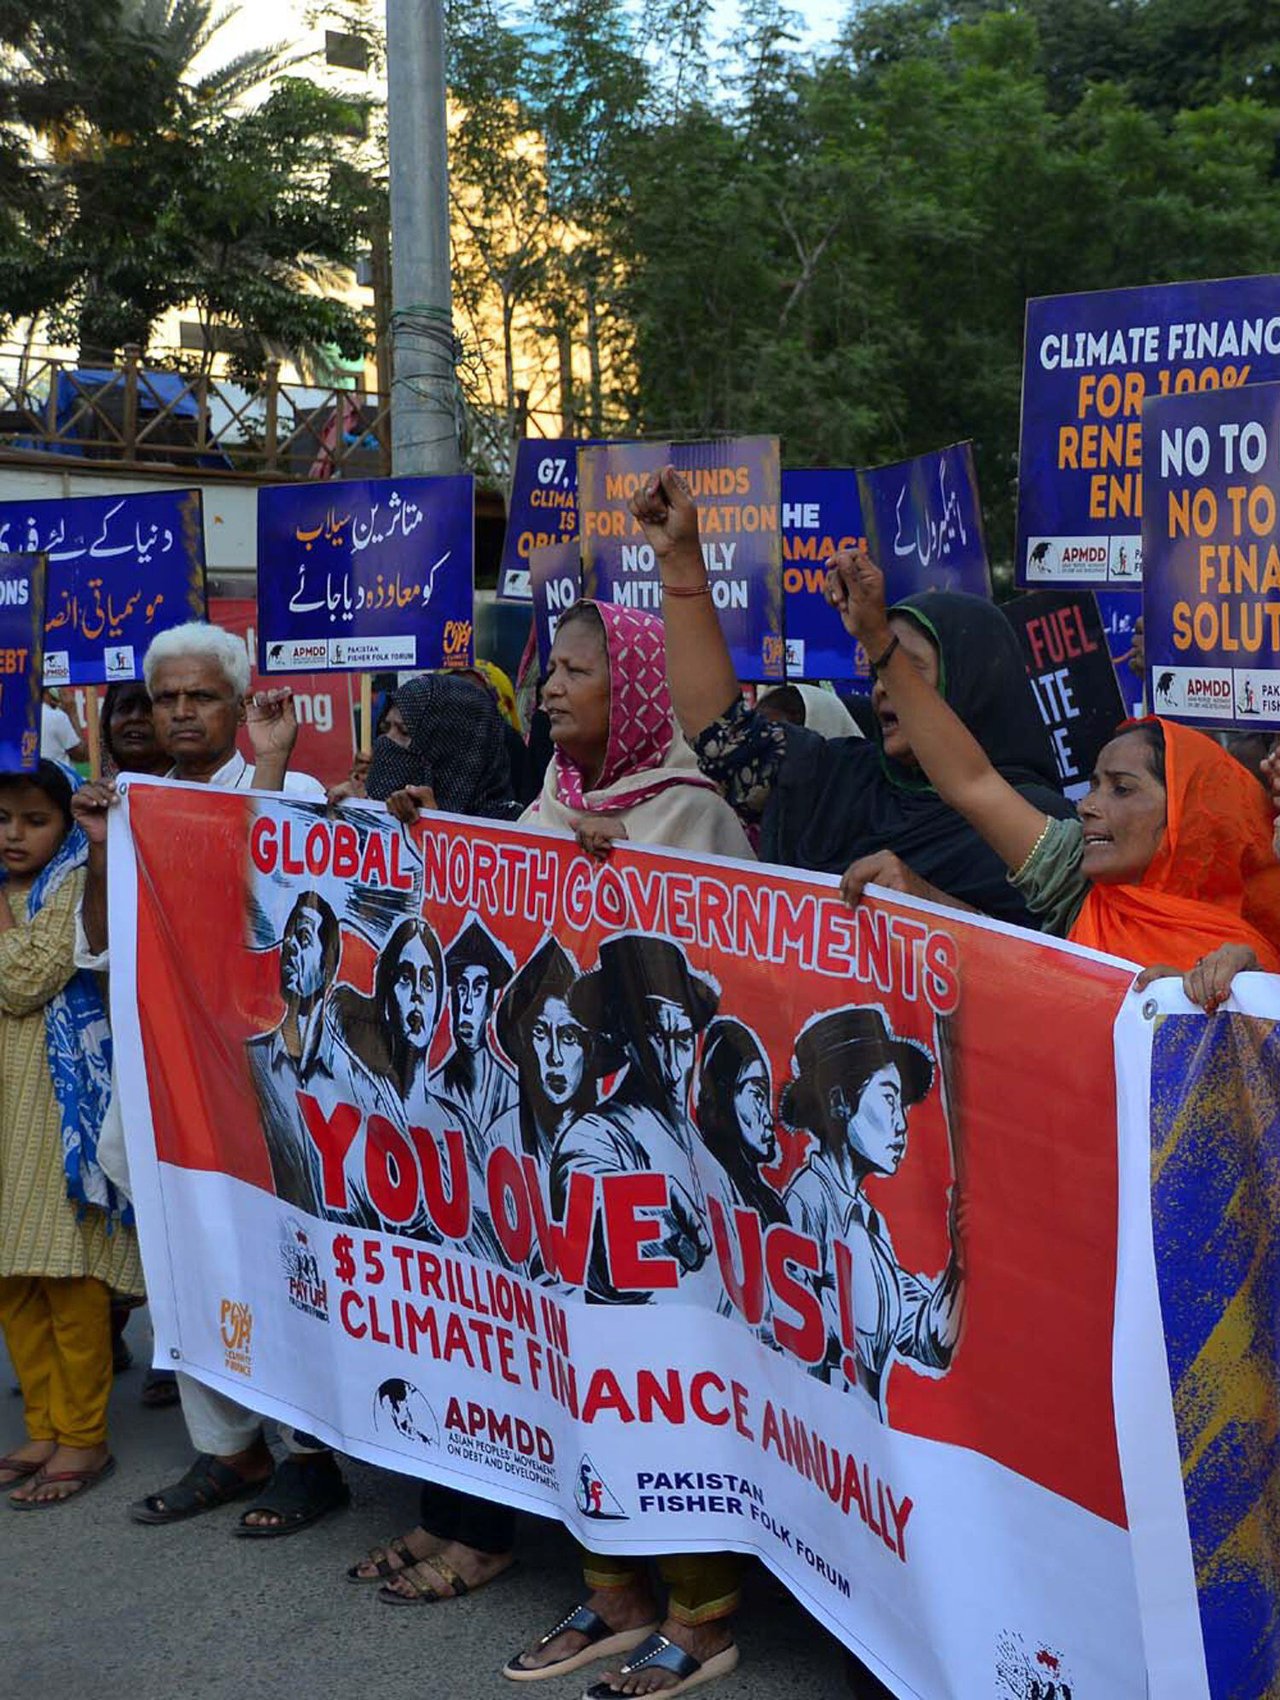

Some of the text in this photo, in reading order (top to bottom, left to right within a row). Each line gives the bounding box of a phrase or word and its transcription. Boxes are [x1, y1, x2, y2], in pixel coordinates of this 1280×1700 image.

[1040, 326, 1159, 370] CLIMATE
[1077, 374, 1144, 418] FOR
[1160, 426, 1211, 478] NO
[1219, 422, 1268, 474] TO
[537, 458, 570, 488] G7,
[89, 500, 135, 558] کے
[559, 511, 576, 531] IS
[585, 511, 626, 537] FOR
[782, 503, 820, 529] HE
[1168, 487, 1217, 539] NO
[1227, 484, 1276, 536] TO
[136, 521, 173, 563] دنیا
[1062, 547, 1106, 562] APMDD
[421, 550, 451, 607] کو
[545, 577, 575, 610] NO
[347, 645, 379, 654] PAKISTAN
[443, 626, 472, 654] UP!
[444, 620, 471, 639] PAY
[1026, 605, 1098, 669] FUEL
[293, 646, 326, 657] APMDD
[372, 653, 390, 662] FOLK
[1187, 679, 1231, 697] APMDD
[250, 816, 960, 1014] GLOBAL NORTH GOVERNMENTS
[296, 1090, 857, 1386] YOU OWE US!
[289, 1277, 308, 1302] PAY
[394, 1244, 538, 1334] TRILLION
[541, 1296, 569, 1356] IN
[340, 1290, 914, 1563] CLIMATE FINANCE ANNUALLY
[445, 1397, 555, 1465] APMDD
[447, 1444, 560, 1491] ON DEBT AND DEVELOPMENT
[448, 1432, 474, 1449] ASIAN
[513, 1455, 556, 1477] MOVEMENT
[637, 1472, 765, 1502] PAKISTAN
[639, 1494, 851, 1598] FISHER FOLK FORUM
